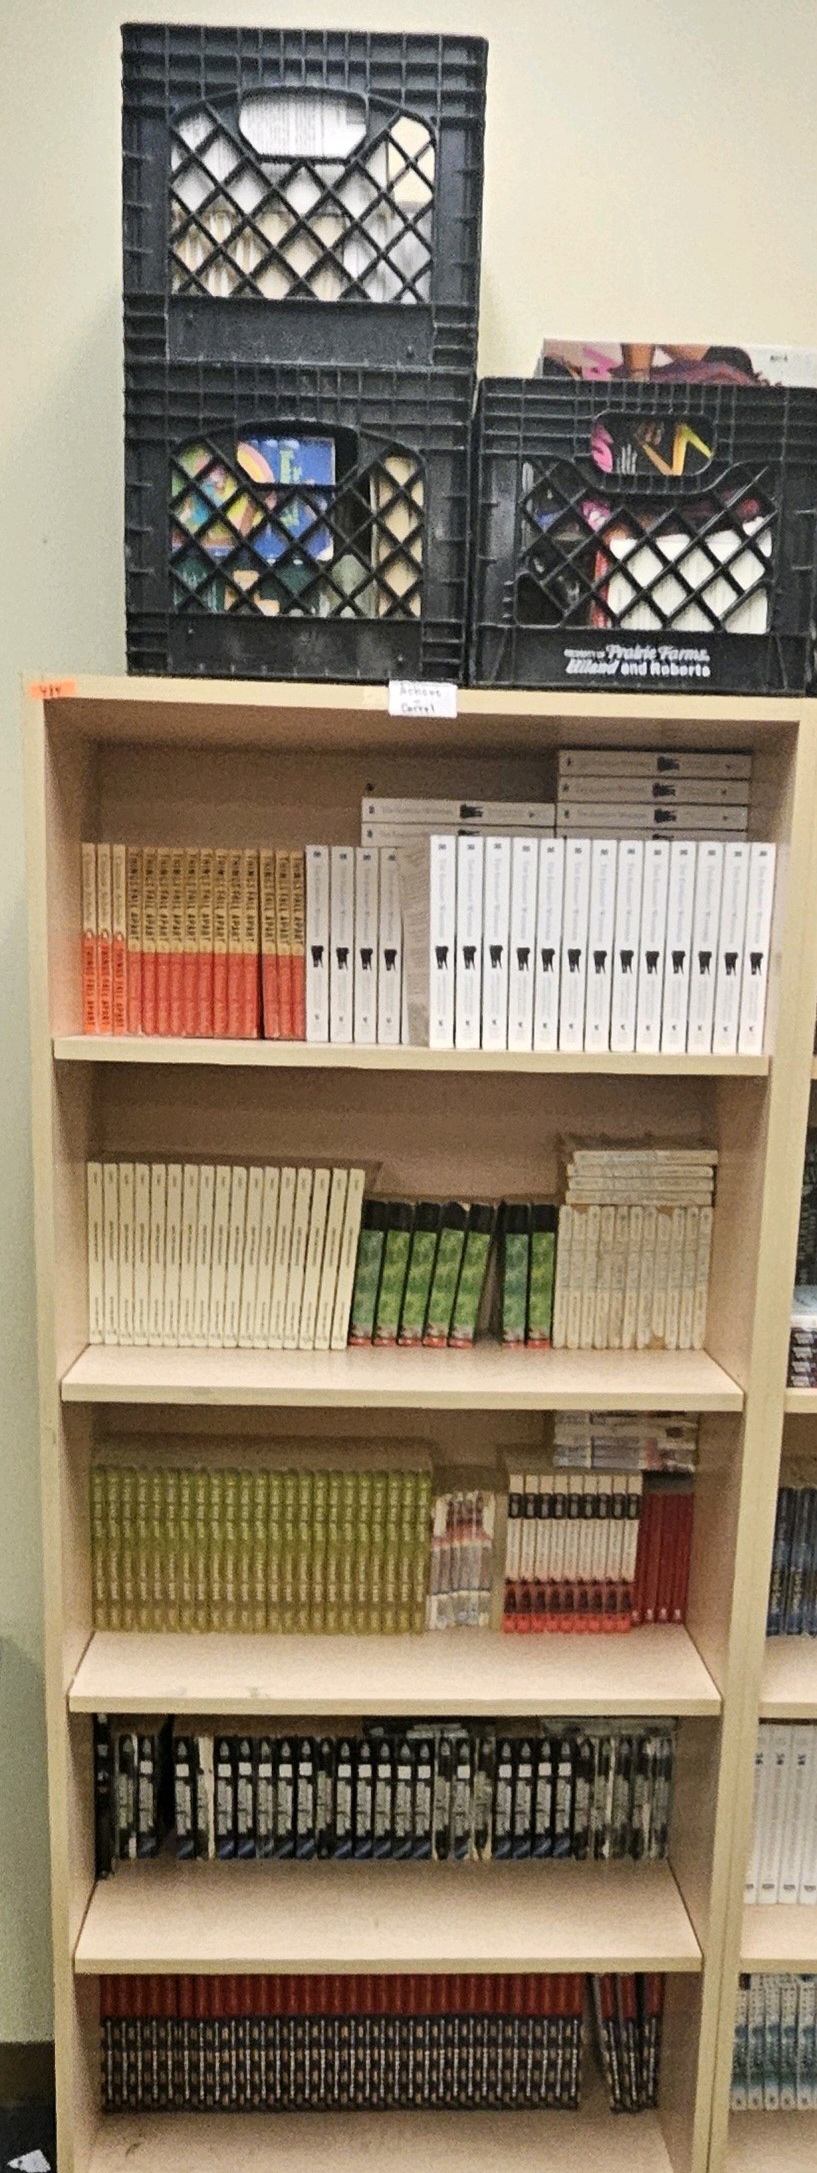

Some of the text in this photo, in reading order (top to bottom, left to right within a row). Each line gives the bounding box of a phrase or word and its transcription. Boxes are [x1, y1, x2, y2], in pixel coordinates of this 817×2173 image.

[605, 643, 656, 660] Prairie
[620, 660, 648, 676] and
[650, 661, 711, 678] Roberts
